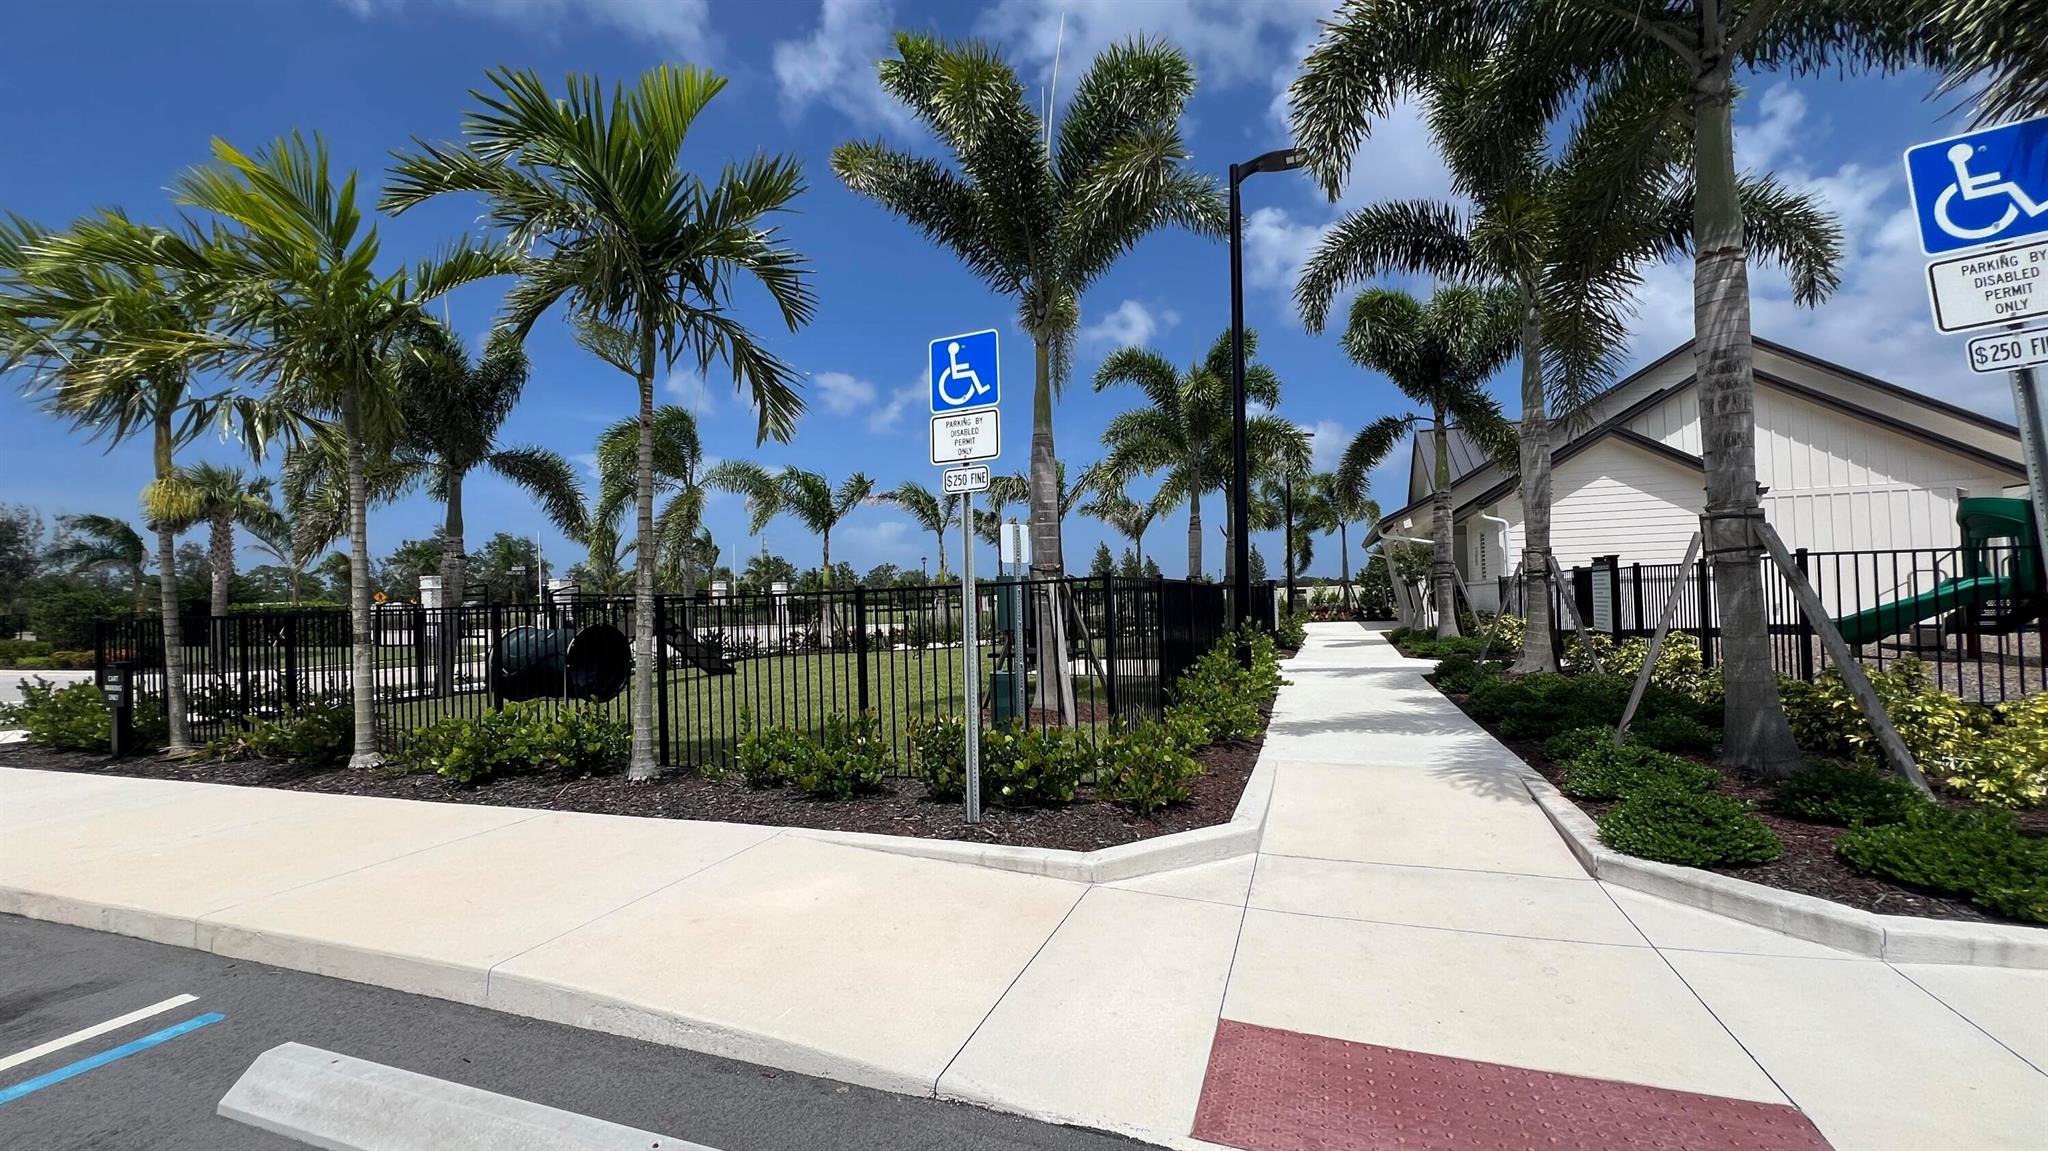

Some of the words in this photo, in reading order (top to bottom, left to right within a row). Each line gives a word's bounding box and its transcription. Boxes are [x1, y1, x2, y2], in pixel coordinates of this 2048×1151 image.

[1961, 255, 2018, 276] PARKING
[2029, 249, 2047, 263] BY
[1974, 266, 2040, 288] DISABLED
[1985, 282, 2033, 301] PERMIT
[1995, 298, 2028, 314] ONLY
[1975, 341, 2022, 365] $250
[2031, 336, 2048, 356] FI
[945, 417, 971, 429] PARKING
[975, 417, 984, 425] BY
[950, 427, 979, 438] DISABLED
[954, 437, 975, 446] PERMIT
[957, 447, 972, 456] ONLY
[946, 474, 967, 487] $250
[970, 472, 986, 485] FINE
